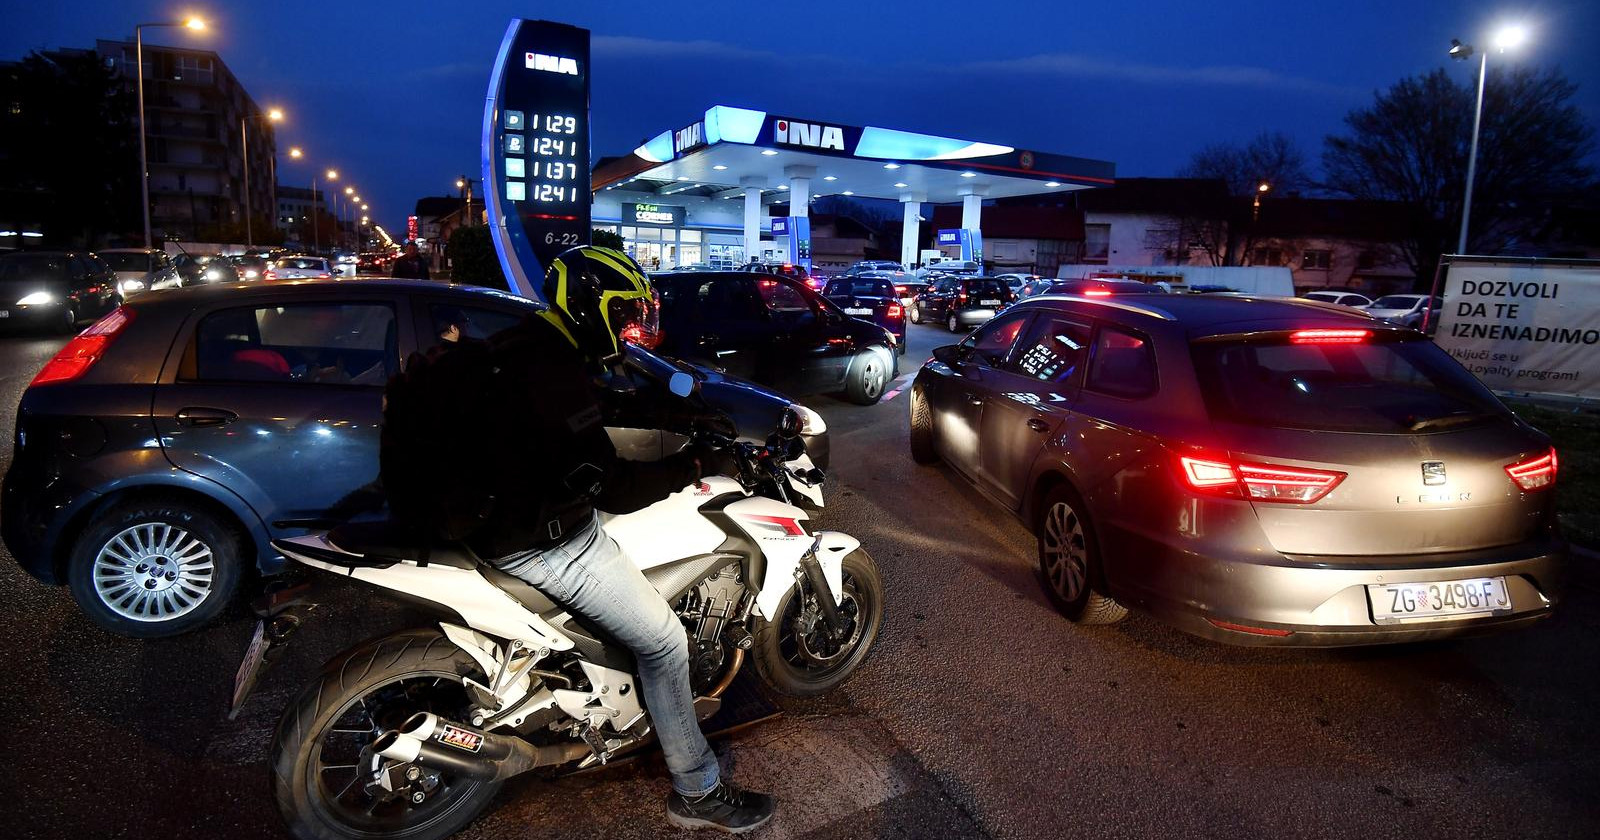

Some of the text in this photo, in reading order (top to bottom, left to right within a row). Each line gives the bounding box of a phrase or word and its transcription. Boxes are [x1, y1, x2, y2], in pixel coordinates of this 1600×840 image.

[525, 52, 578, 75] INA
[533, 114, 576, 134] 11.29
[676, 122, 701, 153] INA
[777, 119, 845, 150] INA
[533, 137, 576, 157] 12.41
[533, 161, 576, 180] 11.37
[534, 184, 577, 203] 12.41
[545, 232, 579, 246] 6-22
[1461, 280, 1559, 299] DOZVOLI
[1457, 302, 1520, 319] DA TE
[1452, 323, 1600, 345] IZNENADIMO
[1491, 352, 1507, 361] se
[1510, 353, 1520, 362] u
[1469, 363, 1580, 381] Loyalty program!
[1387, 588, 1416, 613] ZG
